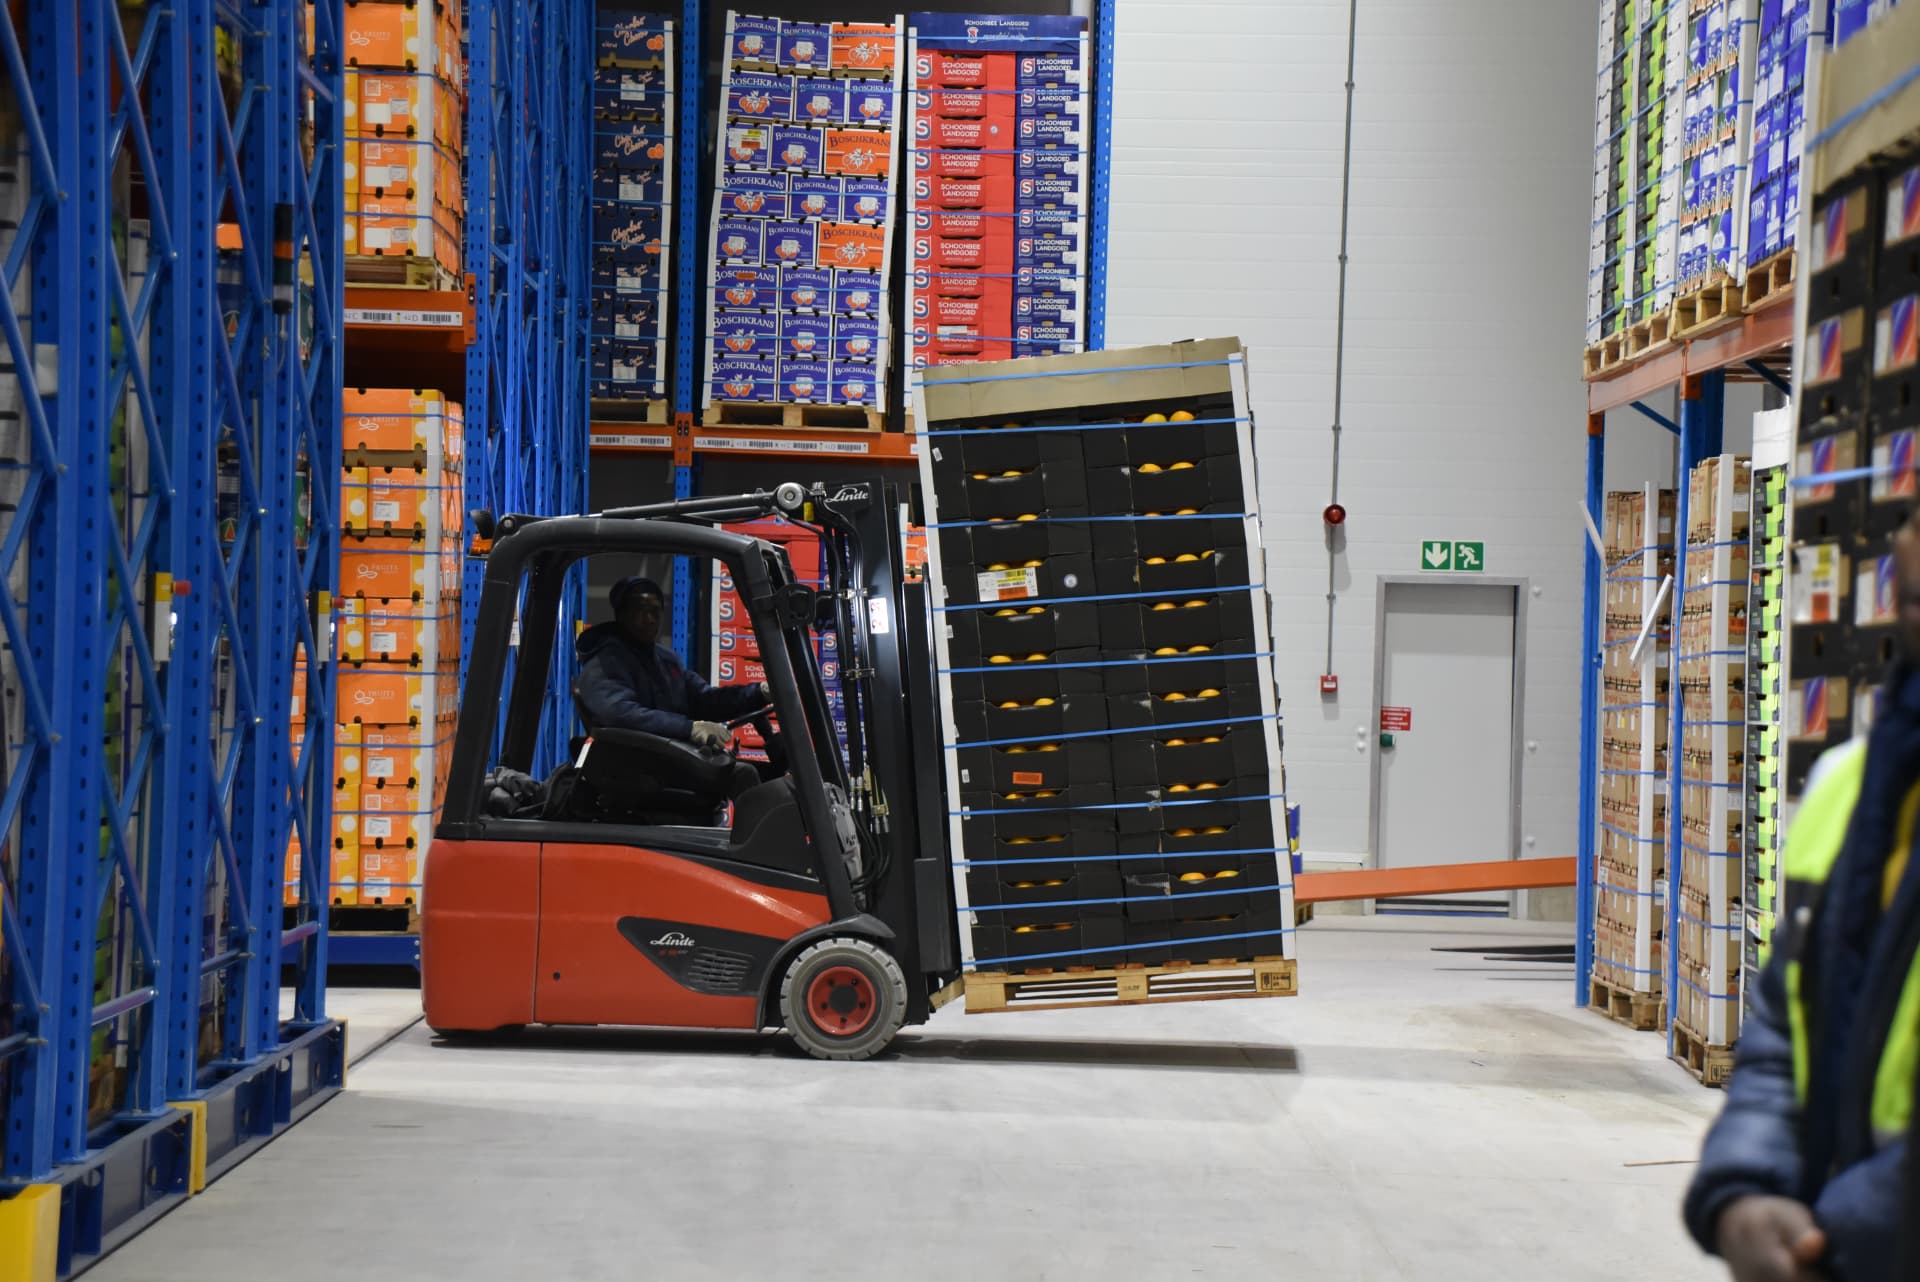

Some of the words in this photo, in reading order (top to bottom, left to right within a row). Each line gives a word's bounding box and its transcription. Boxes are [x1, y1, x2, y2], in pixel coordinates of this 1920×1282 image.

[775, 131, 820, 143] BOSCHKRANS
[723, 176, 785, 191] BOSCHKRANS
[794, 180, 839, 192] BOSCHKRANS
[768, 224, 812, 236] BOSCHKRANS
[714, 270, 776, 283] BOSCANS
[784, 272, 829, 283] BOSCHKRANS
[784, 318, 829, 329] BOSCHKRANS
[782, 363, 827, 374] BOSCHKRANS
[824, 487, 868, 503] Linde
[650, 932, 695, 946] Linde
